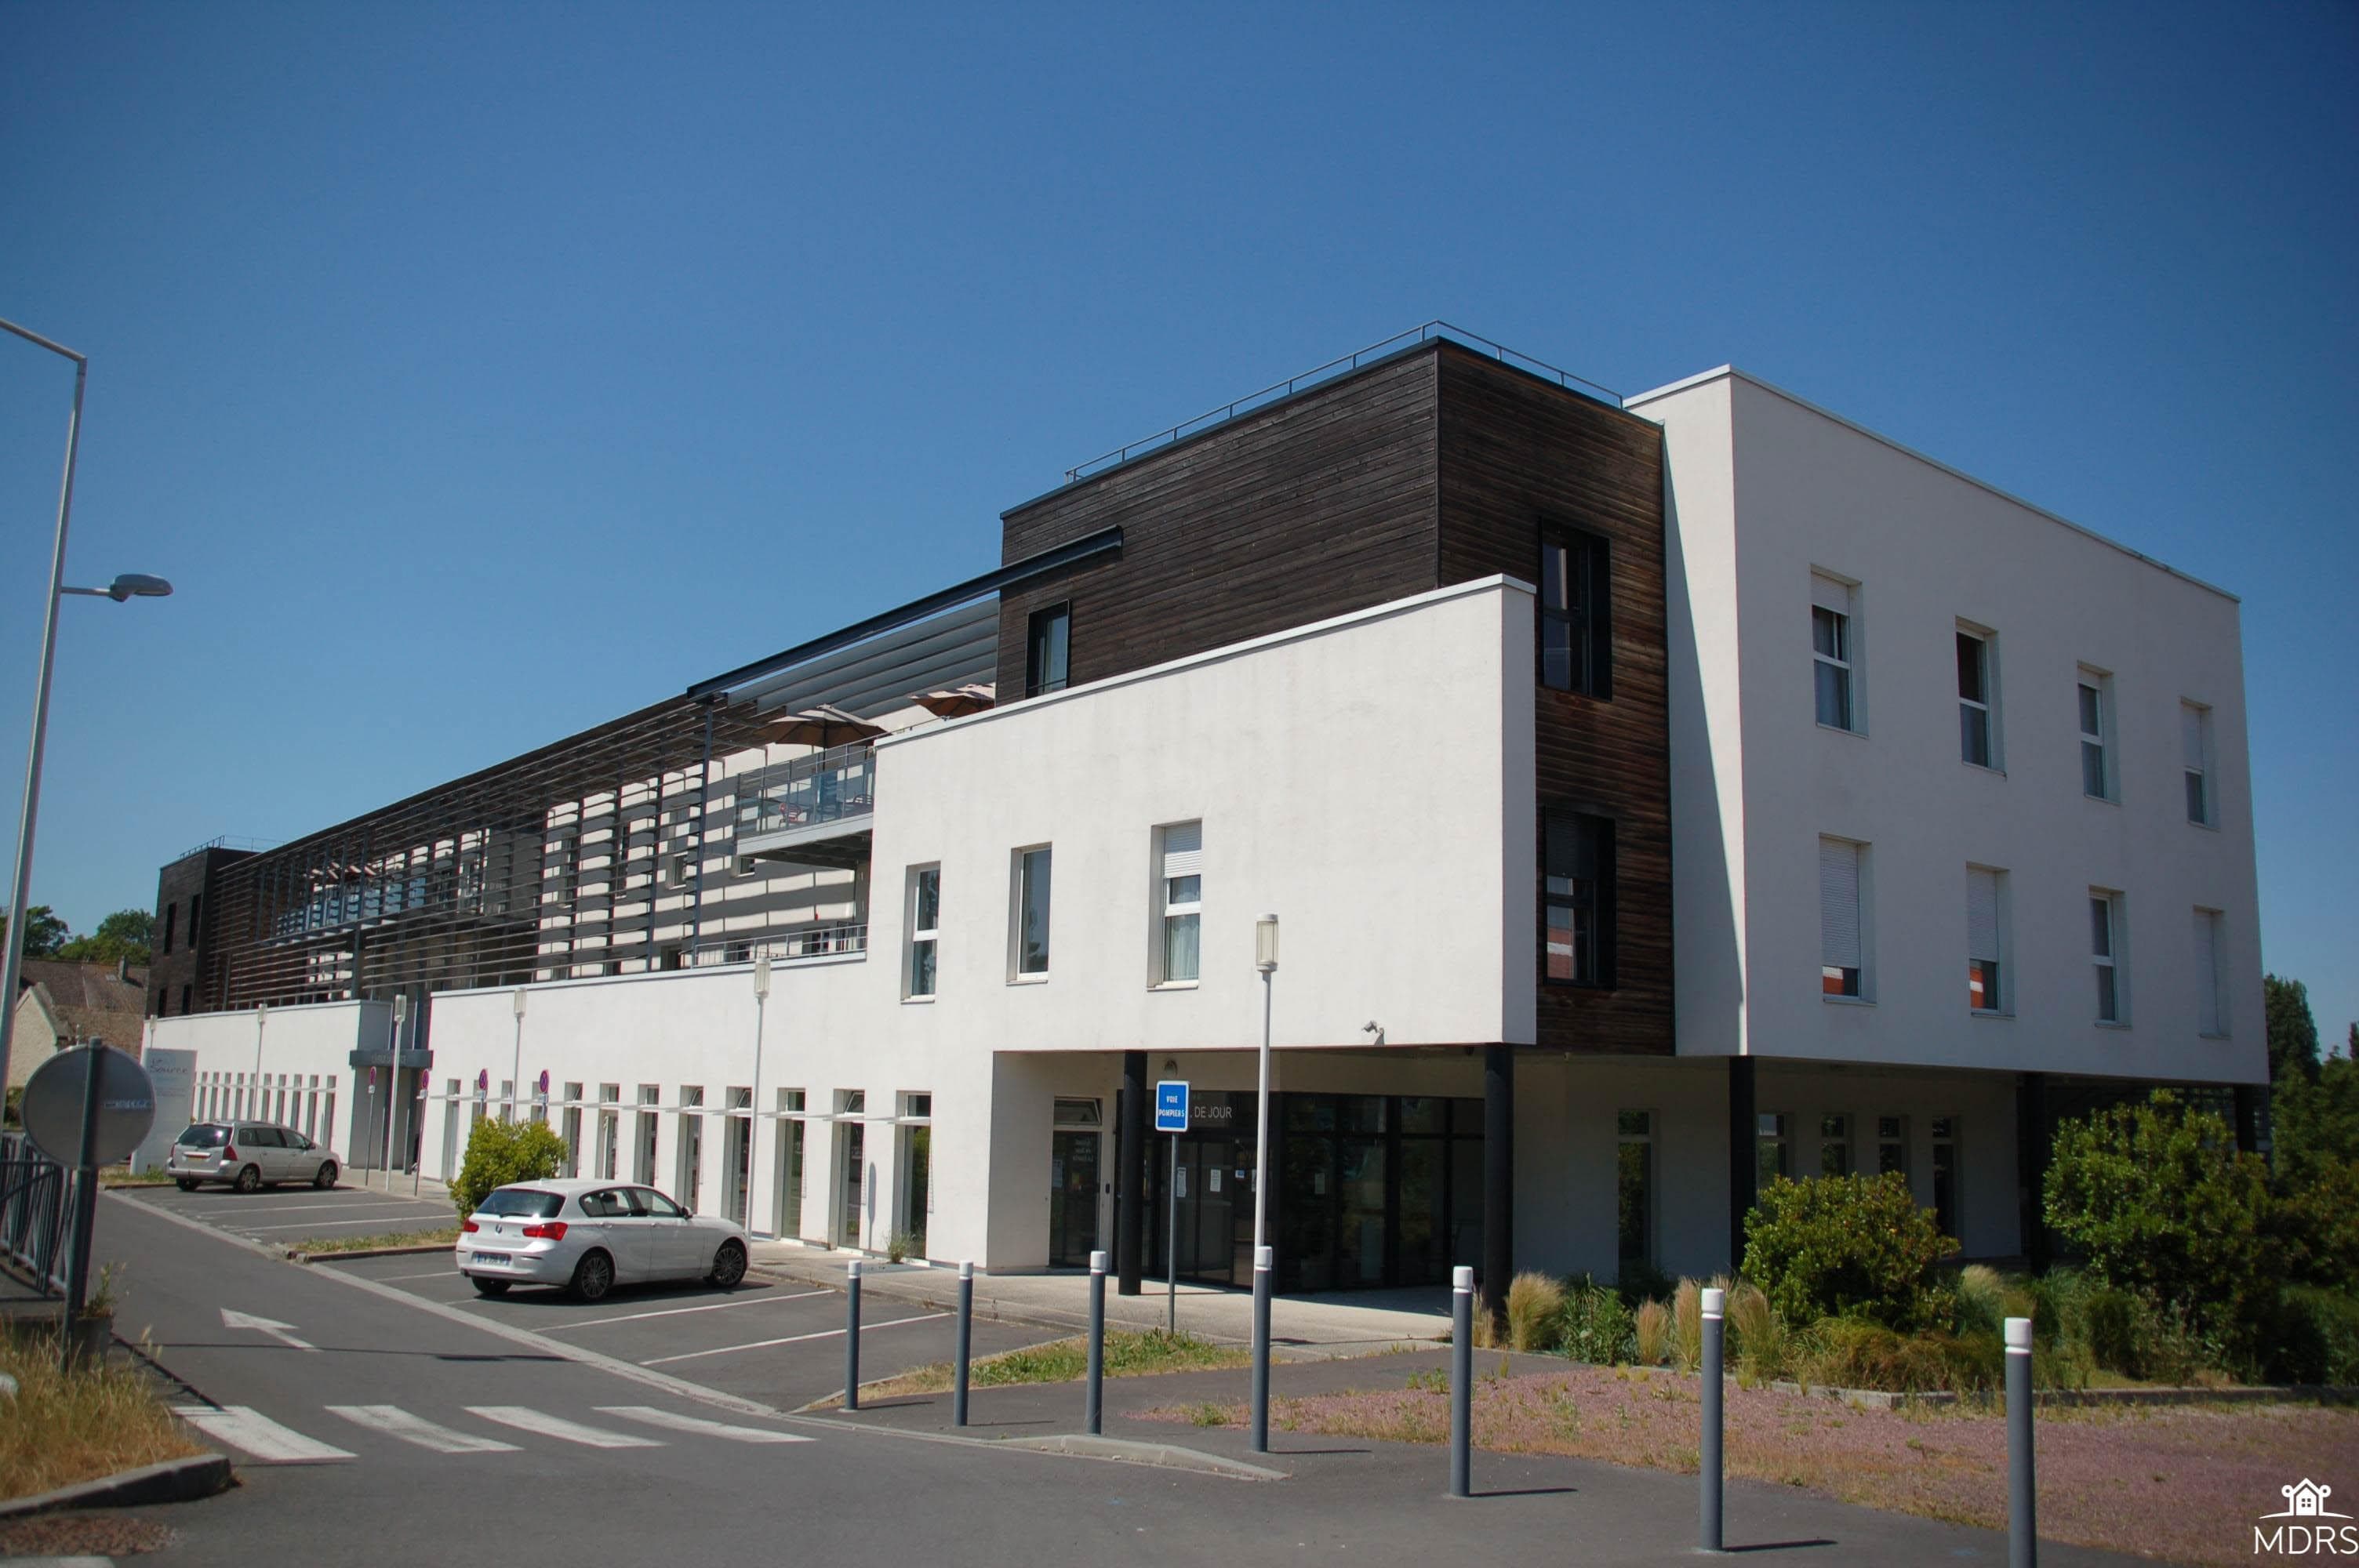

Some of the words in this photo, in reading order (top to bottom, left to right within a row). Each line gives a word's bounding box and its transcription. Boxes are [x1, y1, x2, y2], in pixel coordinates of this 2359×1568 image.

[1158, 1109, 1185, 1117] POMPIERS
[1194, 1106, 1206, 1118] DE
[1208, 1106, 1233, 1119] JOUR
